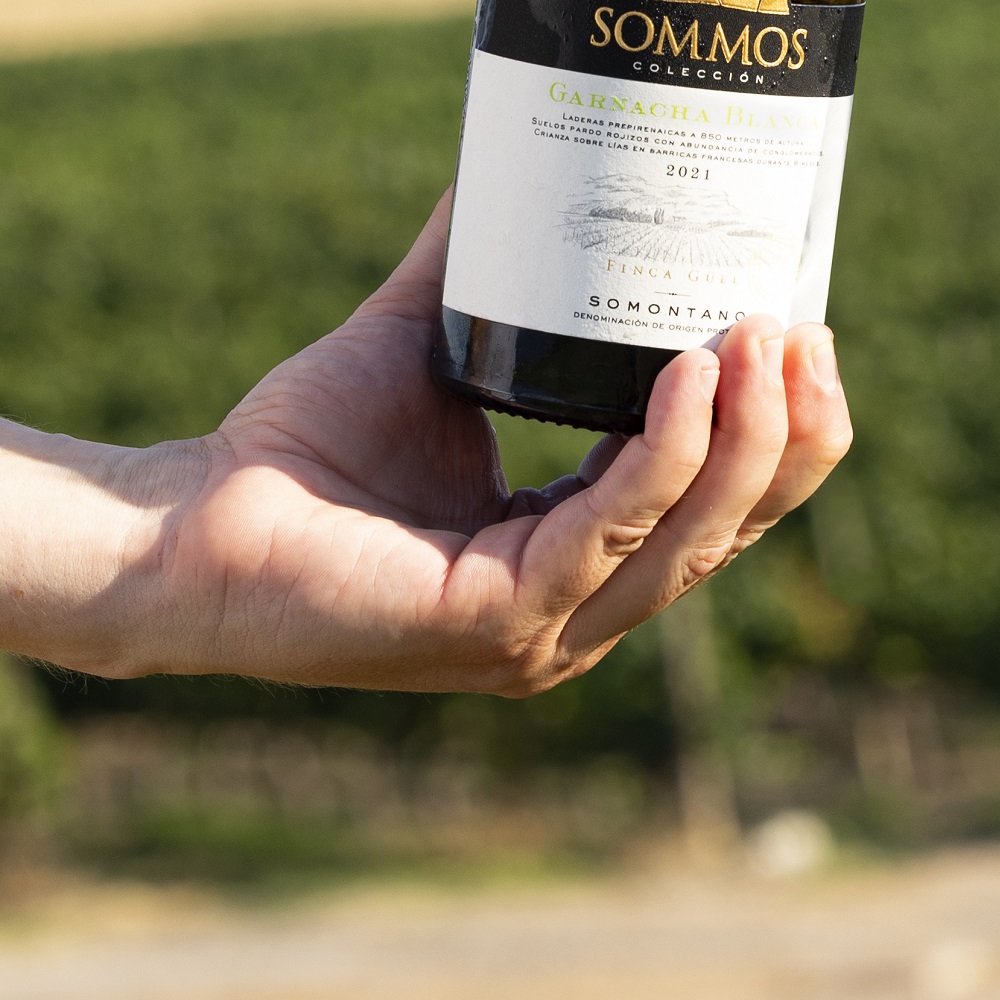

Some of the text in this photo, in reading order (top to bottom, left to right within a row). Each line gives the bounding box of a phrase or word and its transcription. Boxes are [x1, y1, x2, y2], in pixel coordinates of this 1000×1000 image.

[589, 6, 809, 70] SOMMOS
[632, 61, 764, 85] COLECCIÓN
[549, 81, 711, 123] GARNACHA
[531, 116, 566, 131] SUELOS
[569, 125, 602, 137] PARDO
[606, 131, 649, 143] ROJIZOS
[654, 138, 675, 146] CON
[680, 141, 743, 153] ABUNDANCIA
[562, 112, 605, 127] LADERAS
[608, 121, 686, 137] PREPIRENAICAS
[700, 132, 722, 141] 850
[533, 128, 570, 142] CRIANZA
[573, 136, 604, 147] SOBRE
[607, 141, 629, 151] LÍAS
[632, 145, 645, 153] EN
[650, 148, 698, 159] BARRICAS
[701, 154, 753, 164] FRANCESAS
[666, 164, 710, 180] 2021
[606, 258, 673, 280] FINCA
[573, 311, 649, 328] DENOMINACIÓN
[652, 322, 665, 330] DE
[668, 324, 704, 333] ORIGEN
[588, 295, 746, 322] SOMONTANO
